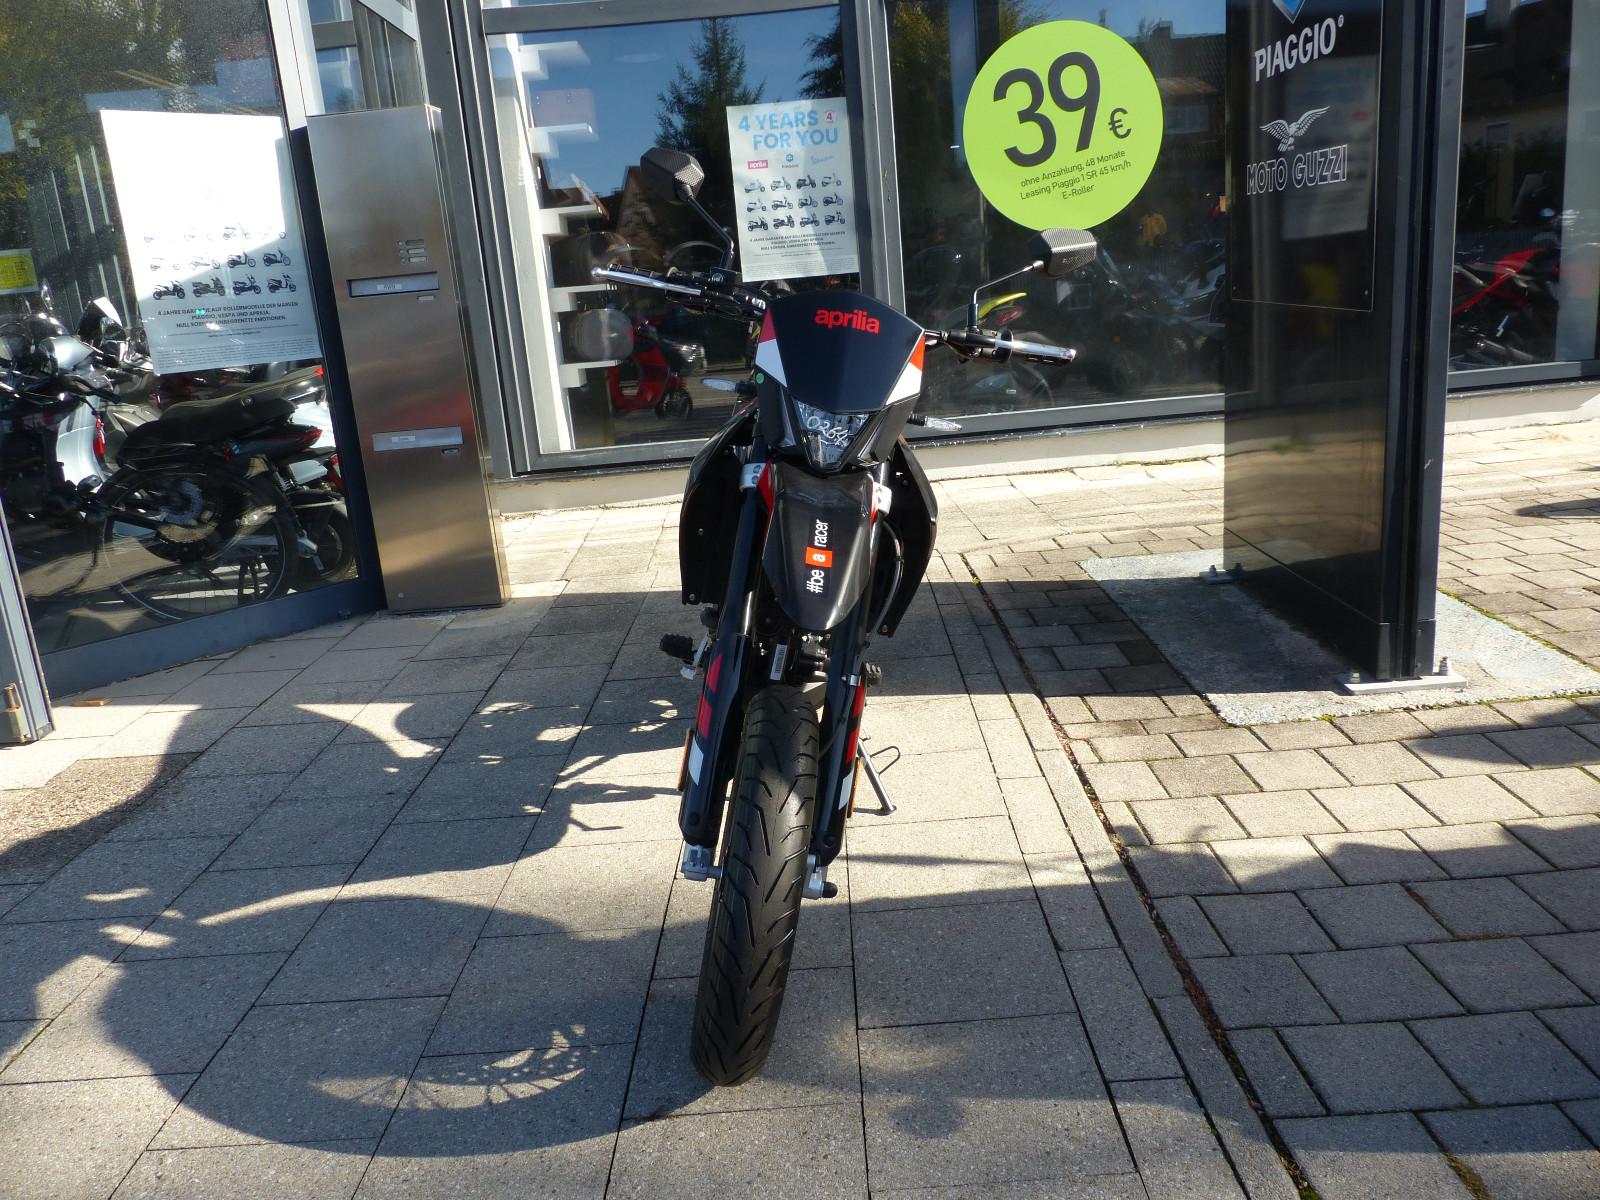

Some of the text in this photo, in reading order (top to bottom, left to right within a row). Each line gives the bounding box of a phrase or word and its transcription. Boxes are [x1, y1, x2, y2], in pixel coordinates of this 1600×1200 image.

[1254, 17, 1337, 82] PIAGGIO
[738, 110, 819, 131] 4 YEARS
[993, 51, 1132, 168] 39 €
[753, 127, 840, 151] FOR YOU
[1020, 150, 1126, 188] ohne Anzahlung, 48 Monate
[1020, 185, 1051, 200] Leasing
[1052, 176, 1081, 191] Piaggio
[1086, 170, 1098, 180] SR
[1099, 167, 1110, 177] 45
[1110, 160, 1132, 173] km/h
[1246, 144, 1348, 196] MOTO GUZZI
[1062, 184, 1095, 200] E-Roller
[814, 308, 880, 335] aprilia
[806, 518, 829, 594] #be a racer
